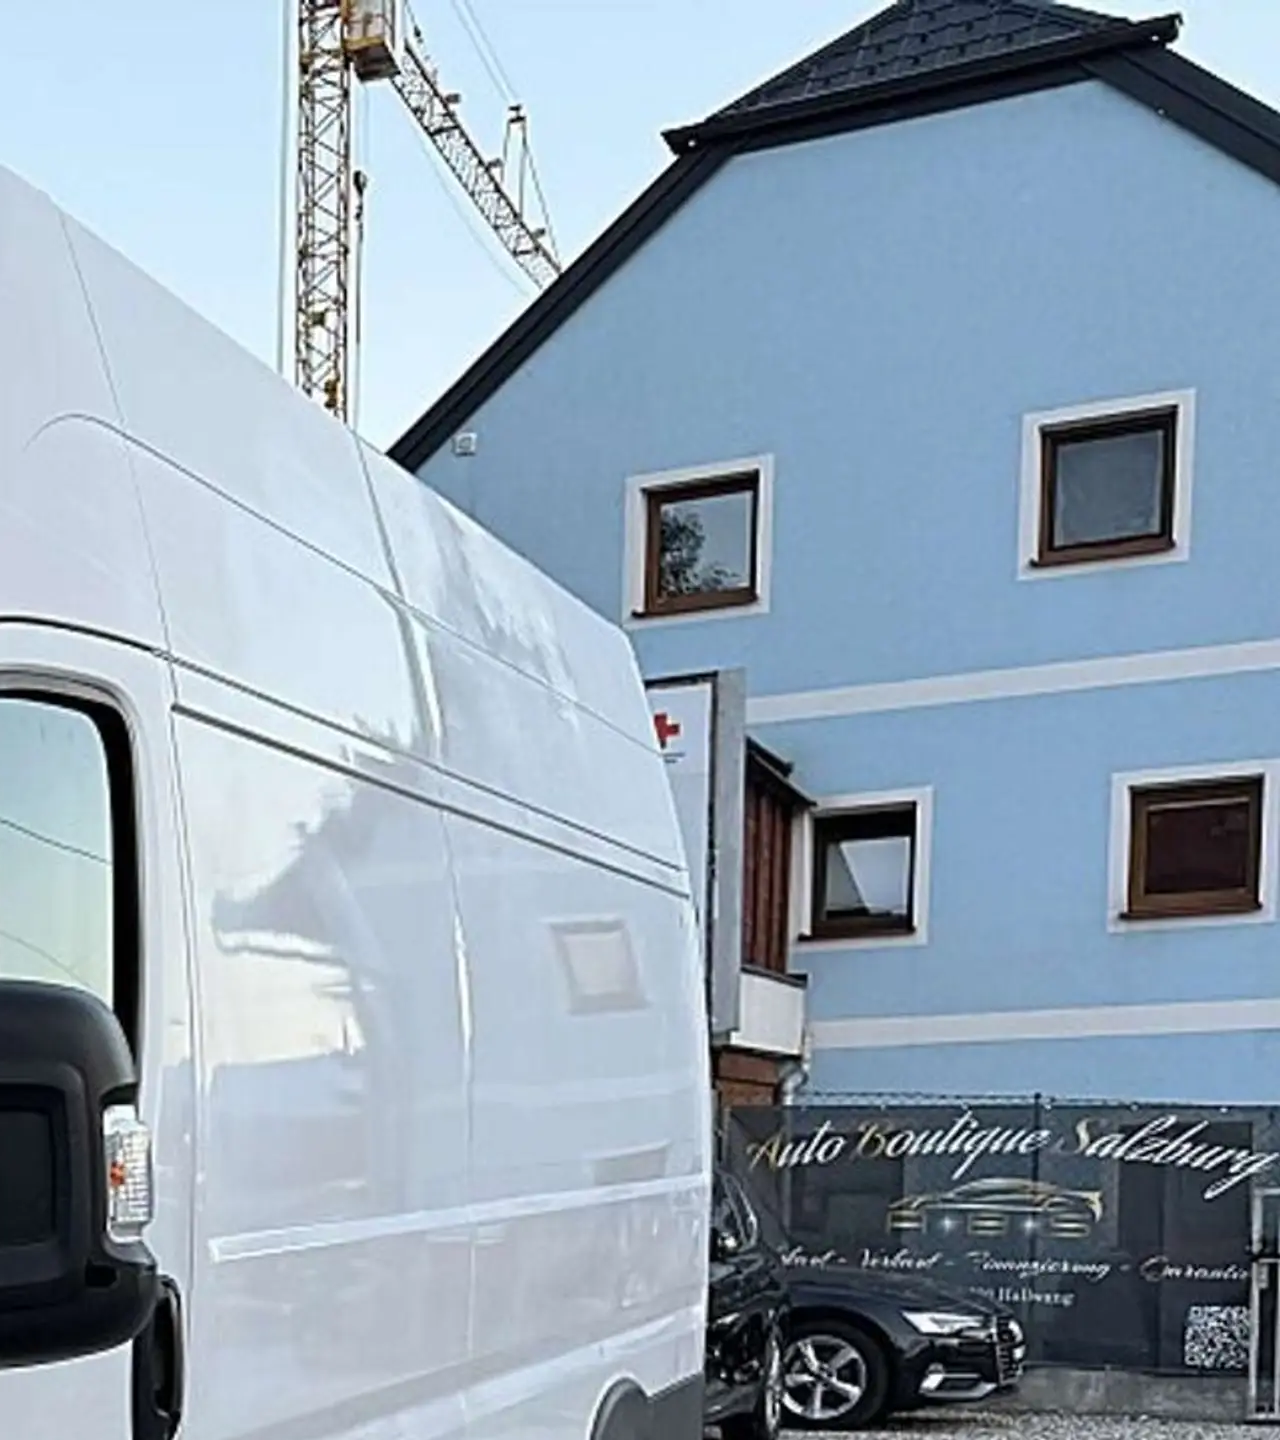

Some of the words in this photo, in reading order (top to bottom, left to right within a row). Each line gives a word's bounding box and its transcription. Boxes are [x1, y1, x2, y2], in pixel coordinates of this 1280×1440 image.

[747, 1119, 847, 1172] Auto
[850, 1110, 1051, 1181] Boutique
[1052, 1113, 1279, 1199] Salzburg
